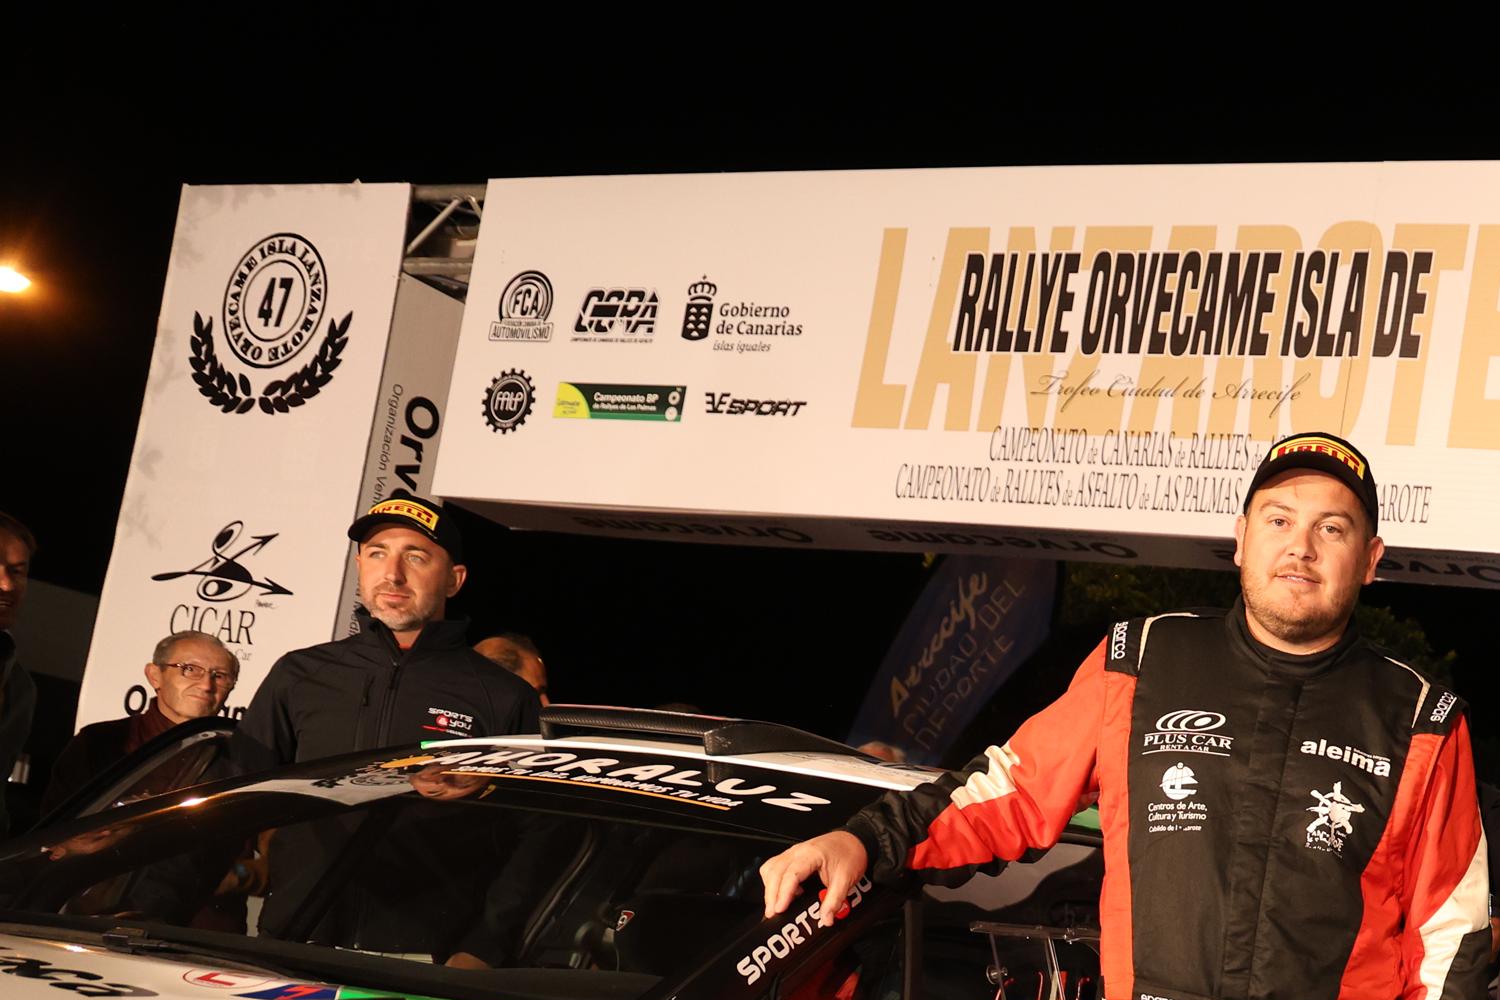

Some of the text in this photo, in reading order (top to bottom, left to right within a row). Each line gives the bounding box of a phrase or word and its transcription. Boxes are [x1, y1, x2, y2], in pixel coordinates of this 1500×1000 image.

[258, 240, 297, 259] ISLA
[257, 277, 294, 327] 47
[268, 246, 321, 361] LANZAROTE
[512, 288, 540, 316] FCA
[719, 302, 790, 318] Gobierno
[953, 251, 1434, 360] RALLYE ORVECAME ISLA DE
[492, 325, 550, 340] AUTOMOVILISMO
[716, 320, 803, 337] de Canarias
[713, 339, 771, 353] islas iguales
[593, 391, 645, 403] Campeonato
[1030, 370, 1302, 418] Trofeo Ciudad de Arrecife
[376, 384, 403, 471] Organización
[394, 396, 440, 492] Orv
[989, 426, 1088, 464] CAMPEONATO
[1088, 438, 1099, 464] de
[1101, 430, 1175, 468] CANARIAS
[1175, 440, 1186, 468] de
[1187, 431, 1252, 471] RALLYES
[895, 463, 991, 502] CAMPEONATO
[1002, 468, 1063, 506] RALLYES
[1074, 472, 1140, 510] ASFALTO
[1152, 474, 1182, 512] LAS
[1181, 476, 1243, 515] PALMAS
[1376, 484, 1432, 523] AROTE
[868, 528, 1138, 559] Orvecame
[170, 604, 255, 645] CICAR
[428, 708, 473, 722] SPORTS
[1144, 734, 1232, 750] PLUS CAR
[1160, 744, 1183, 752] RENT
[1190, 745, 1209, 753] CAR
[1300, 738, 1391, 778] aleima
[1148, 801, 1208, 812] Centros de Arte,
[1148, 812, 1172, 822] Cultura
[1177, 811, 1207, 820] Turismo
